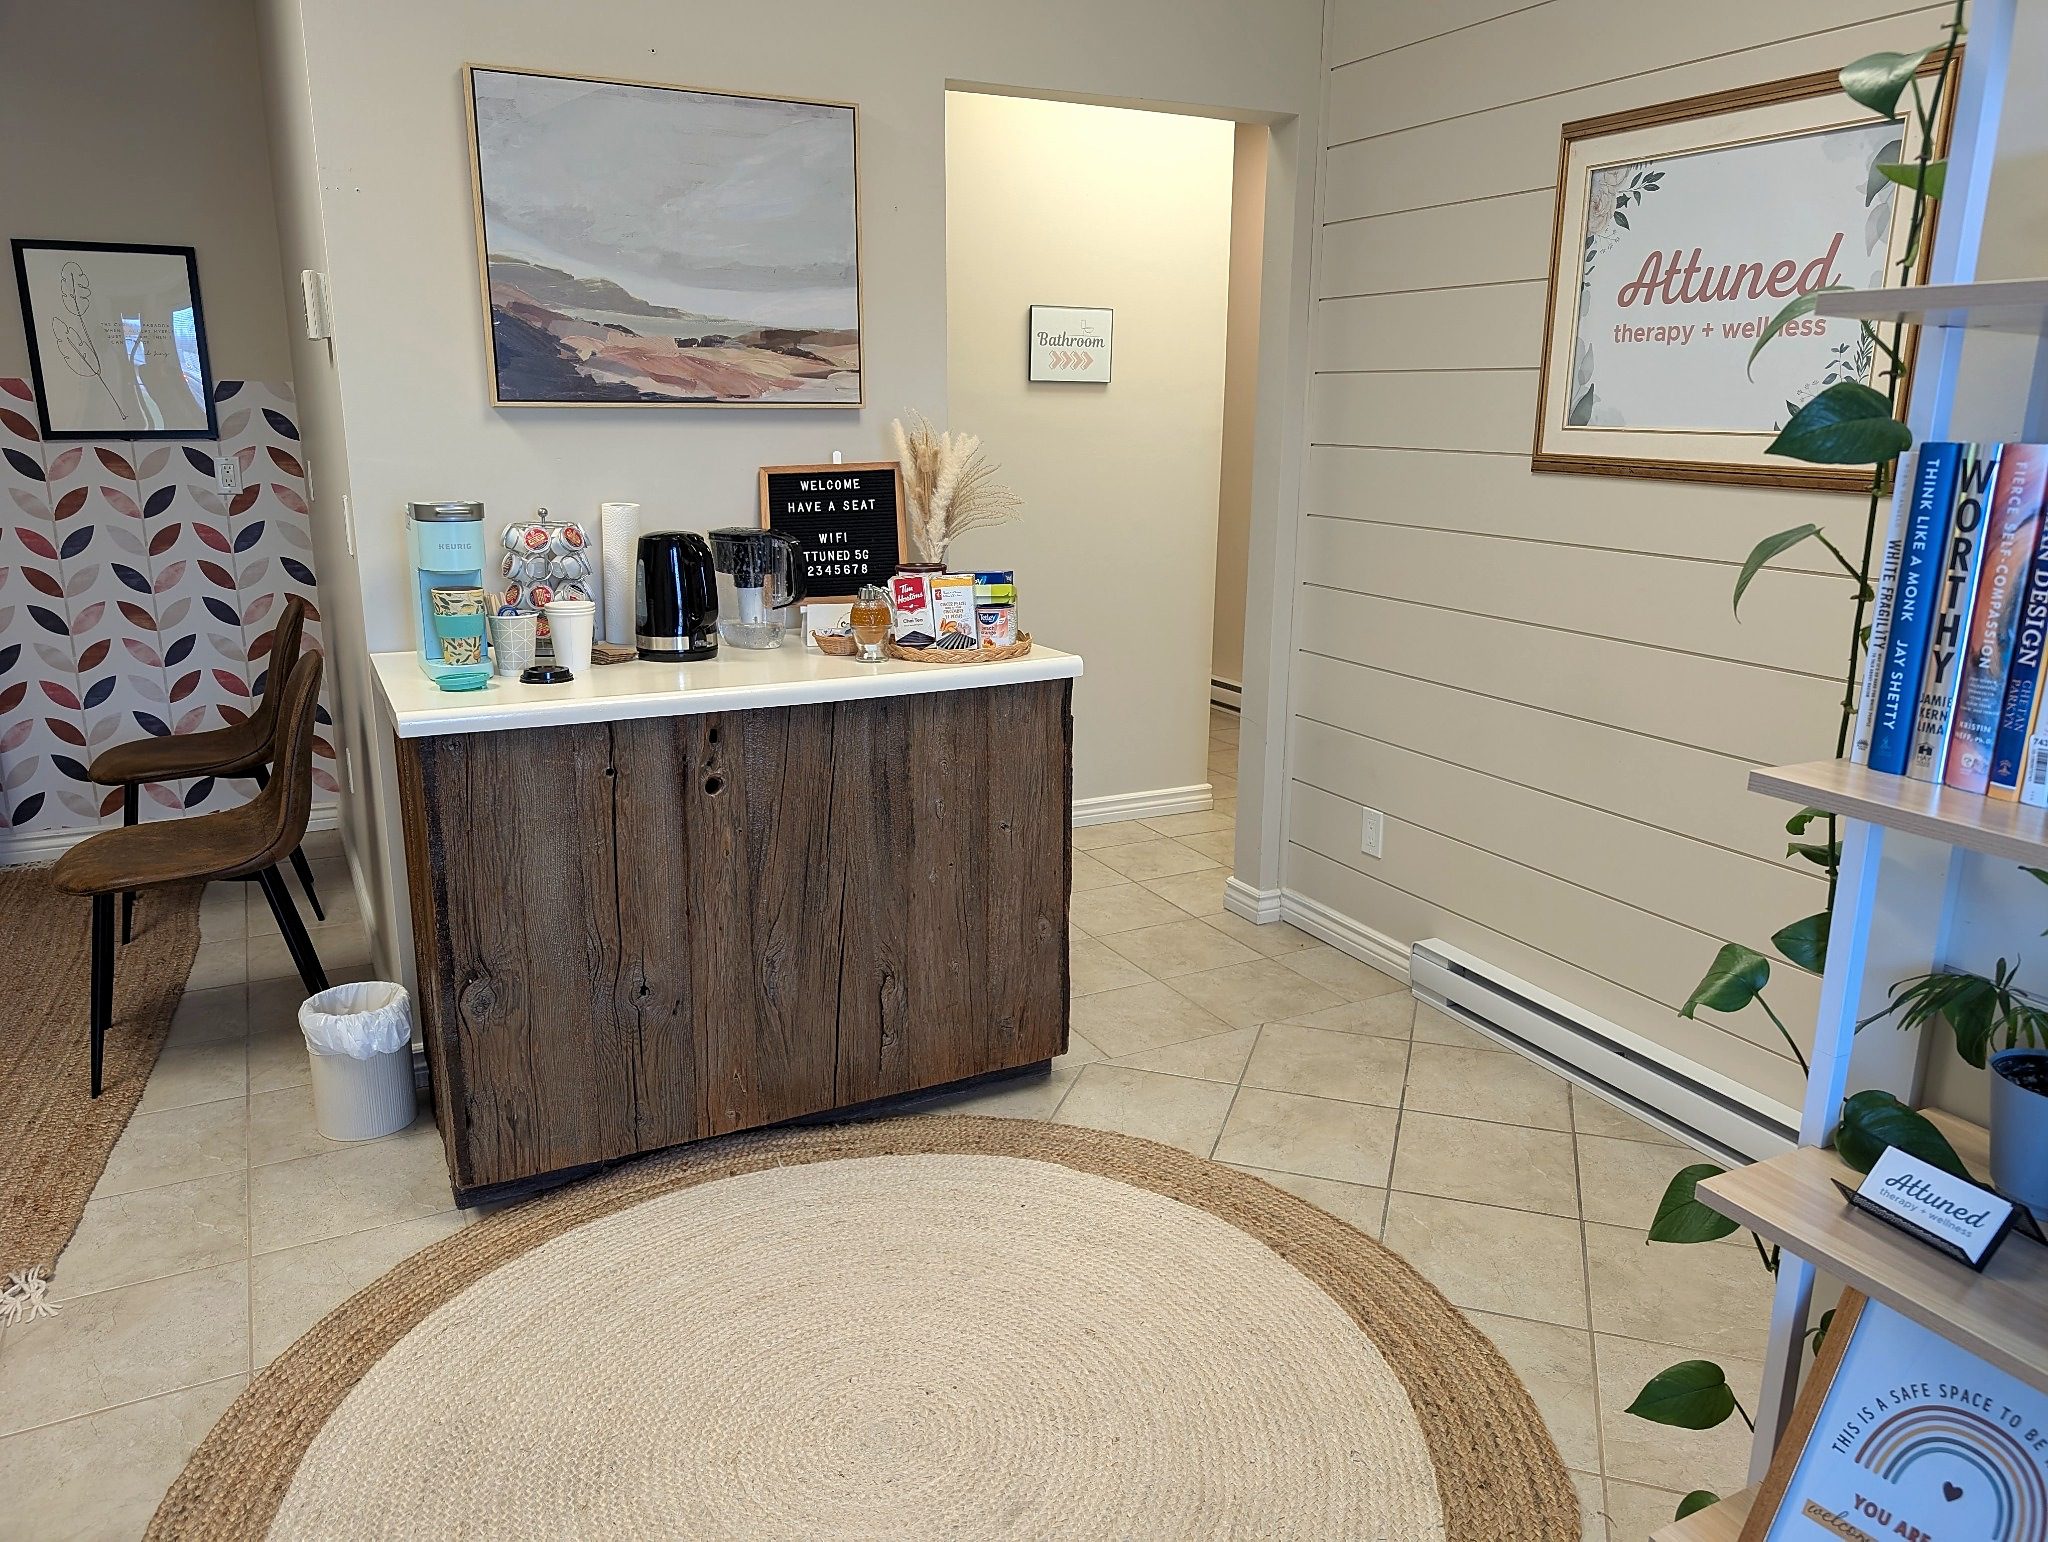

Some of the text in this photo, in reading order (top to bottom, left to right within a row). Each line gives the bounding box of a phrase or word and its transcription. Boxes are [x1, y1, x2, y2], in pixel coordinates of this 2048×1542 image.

[1616, 232, 1844, 308] Attuned
[1036, 331, 1106, 348] Bathroom
[1613, 322, 1695, 346] therapy
[800, 479, 861, 491] WELCOME
[2006, 462, 2028, 514] FIERCE
[787, 499, 876, 513] HAVE A SEAT
[818, 532, 848, 544] WIFI
[854, 549, 869, 561] 5G
[1900, 459, 1940, 622] THINK LIKE A MONK
[899, 583, 914, 594] Tim
[1934, 458, 1999, 684] WORTHY
[897, 592, 924, 604] Hortons
[1873, 540, 1902, 650] WHITE FRAGILITY
[1979, 523, 2016, 668] SELF-COMPASSION
[979, 613, 996, 622] Tetley
[2017, 568, 2048, 668] DESIGN
[1883, 639, 1908, 730] JAY SHETTY
[1920, 693, 1953, 708] JAMIE
[2003, 680, 2021, 730] PARKYN
[1919, 707, 1948, 722] KERN
[2014, 681, 2032, 732] CHETAN
[1917, 720, 1944, 735] LIMA
[1880, 1187, 1919, 1212] therapy
[1928, 1212, 1973, 1238] wellness
[1885, 1174, 1991, 1228] Attuned
[1831, 1383, 2048, 1454] THIS IS A SAFE SPACE TO BE
[1854, 1493, 1892, 1526] YOU
